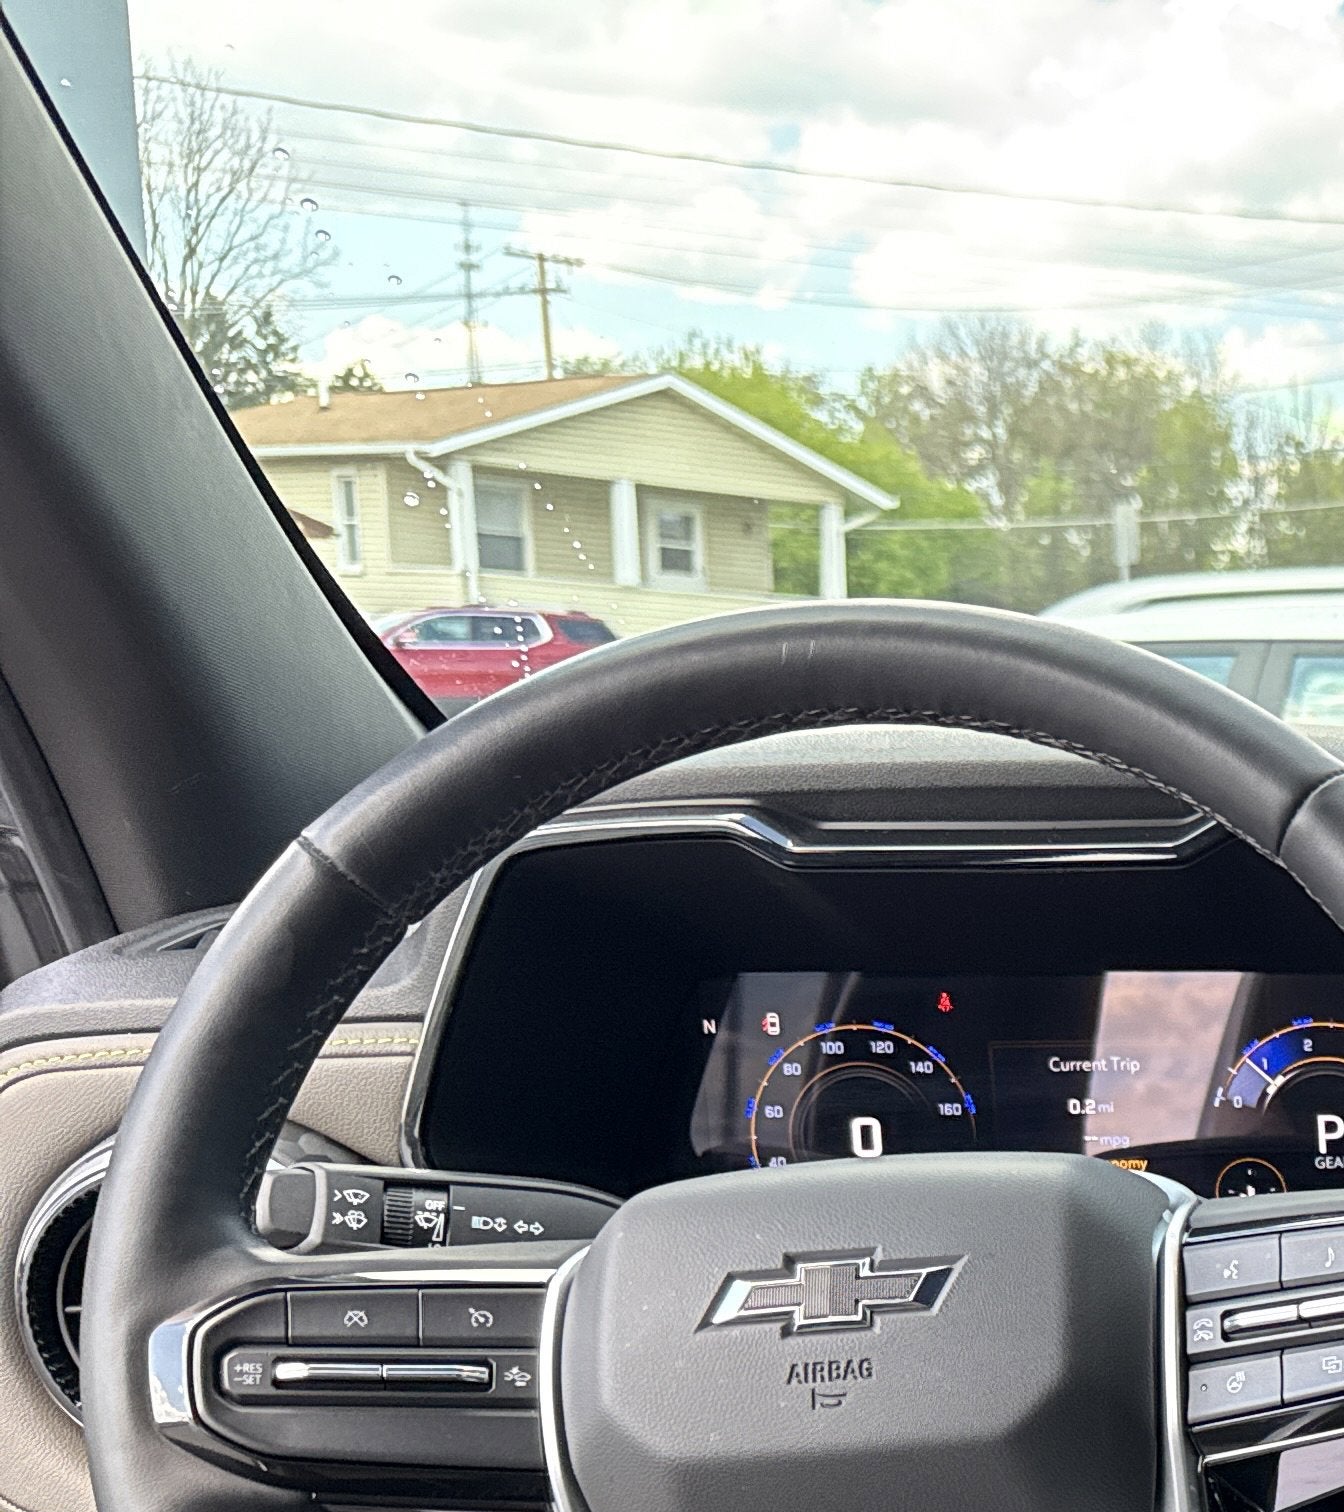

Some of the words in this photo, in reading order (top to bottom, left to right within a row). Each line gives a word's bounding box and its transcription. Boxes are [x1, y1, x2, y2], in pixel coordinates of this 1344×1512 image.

[702, 1019, 717, 1034] N
[820, 1041, 844, 1055] 100
[870, 1040, 894, 1054] 120
[1303, 1038, 1313, 1052] 2
[783, 1063, 802, 1076] 80
[909, 1061, 933, 1074] 140
[1048, 1056, 1108, 1072] Current
[1110, 1056, 1141, 1074] Trip
[1261, 1058, 1268, 1070] 1
[1068, 1098, 1096, 1115] 0.2
[1097, 1101, 1114, 1113] mi
[1233, 1096, 1243, 1108] 0
[764, 1105, 784, 1119] 60
[938, 1103, 962, 1116] 160
[851, 1116, 883, 1158] 0
[1100, 1135, 1131, 1148] mpg
[1316, 1114, 1344, 1155] P
[425, 1199, 446, 1211] OFF
[786, 1357, 873, 1385] AIRBAG
